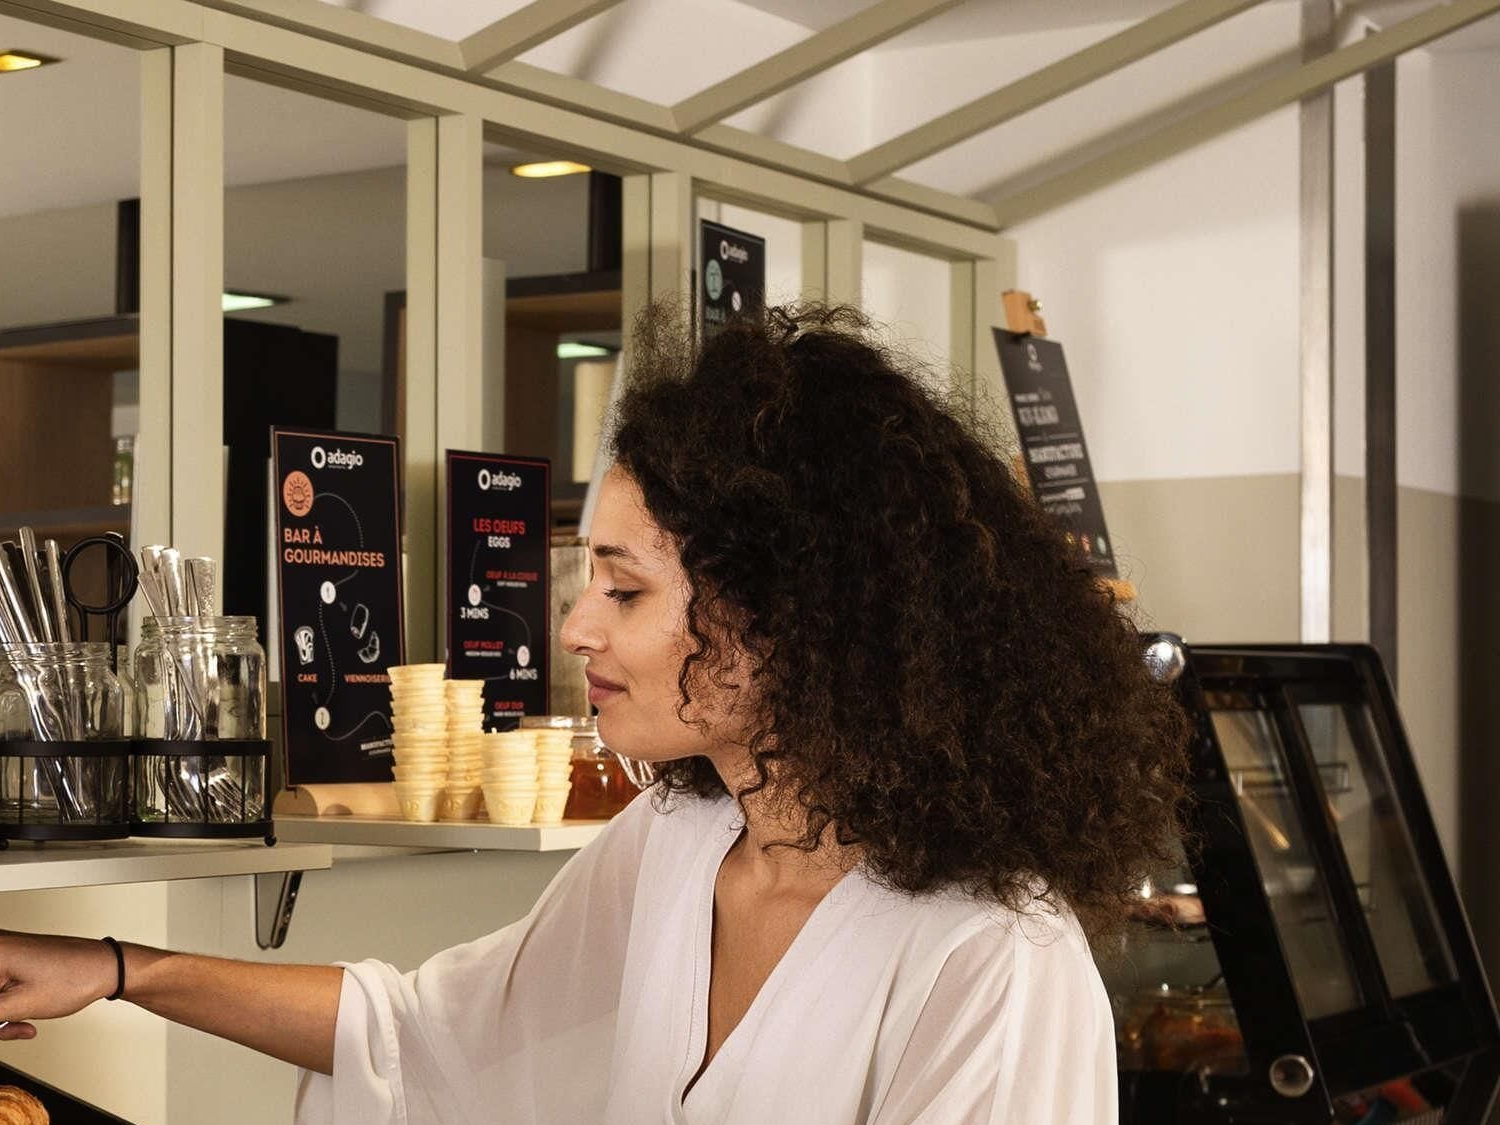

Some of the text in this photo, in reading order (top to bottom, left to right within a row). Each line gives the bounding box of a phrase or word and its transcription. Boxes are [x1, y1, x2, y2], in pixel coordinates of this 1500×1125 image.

[327, 449, 364, 470] adagio
[492, 471, 522, 491] adagio
[284, 525, 323, 545] BAR À
[473, 518, 526, 536] LES OEUFS
[488, 535, 511, 549] EGGS
[284, 548, 386, 568] GOURMANDISES
[298, 673, 318, 683] CAKE
